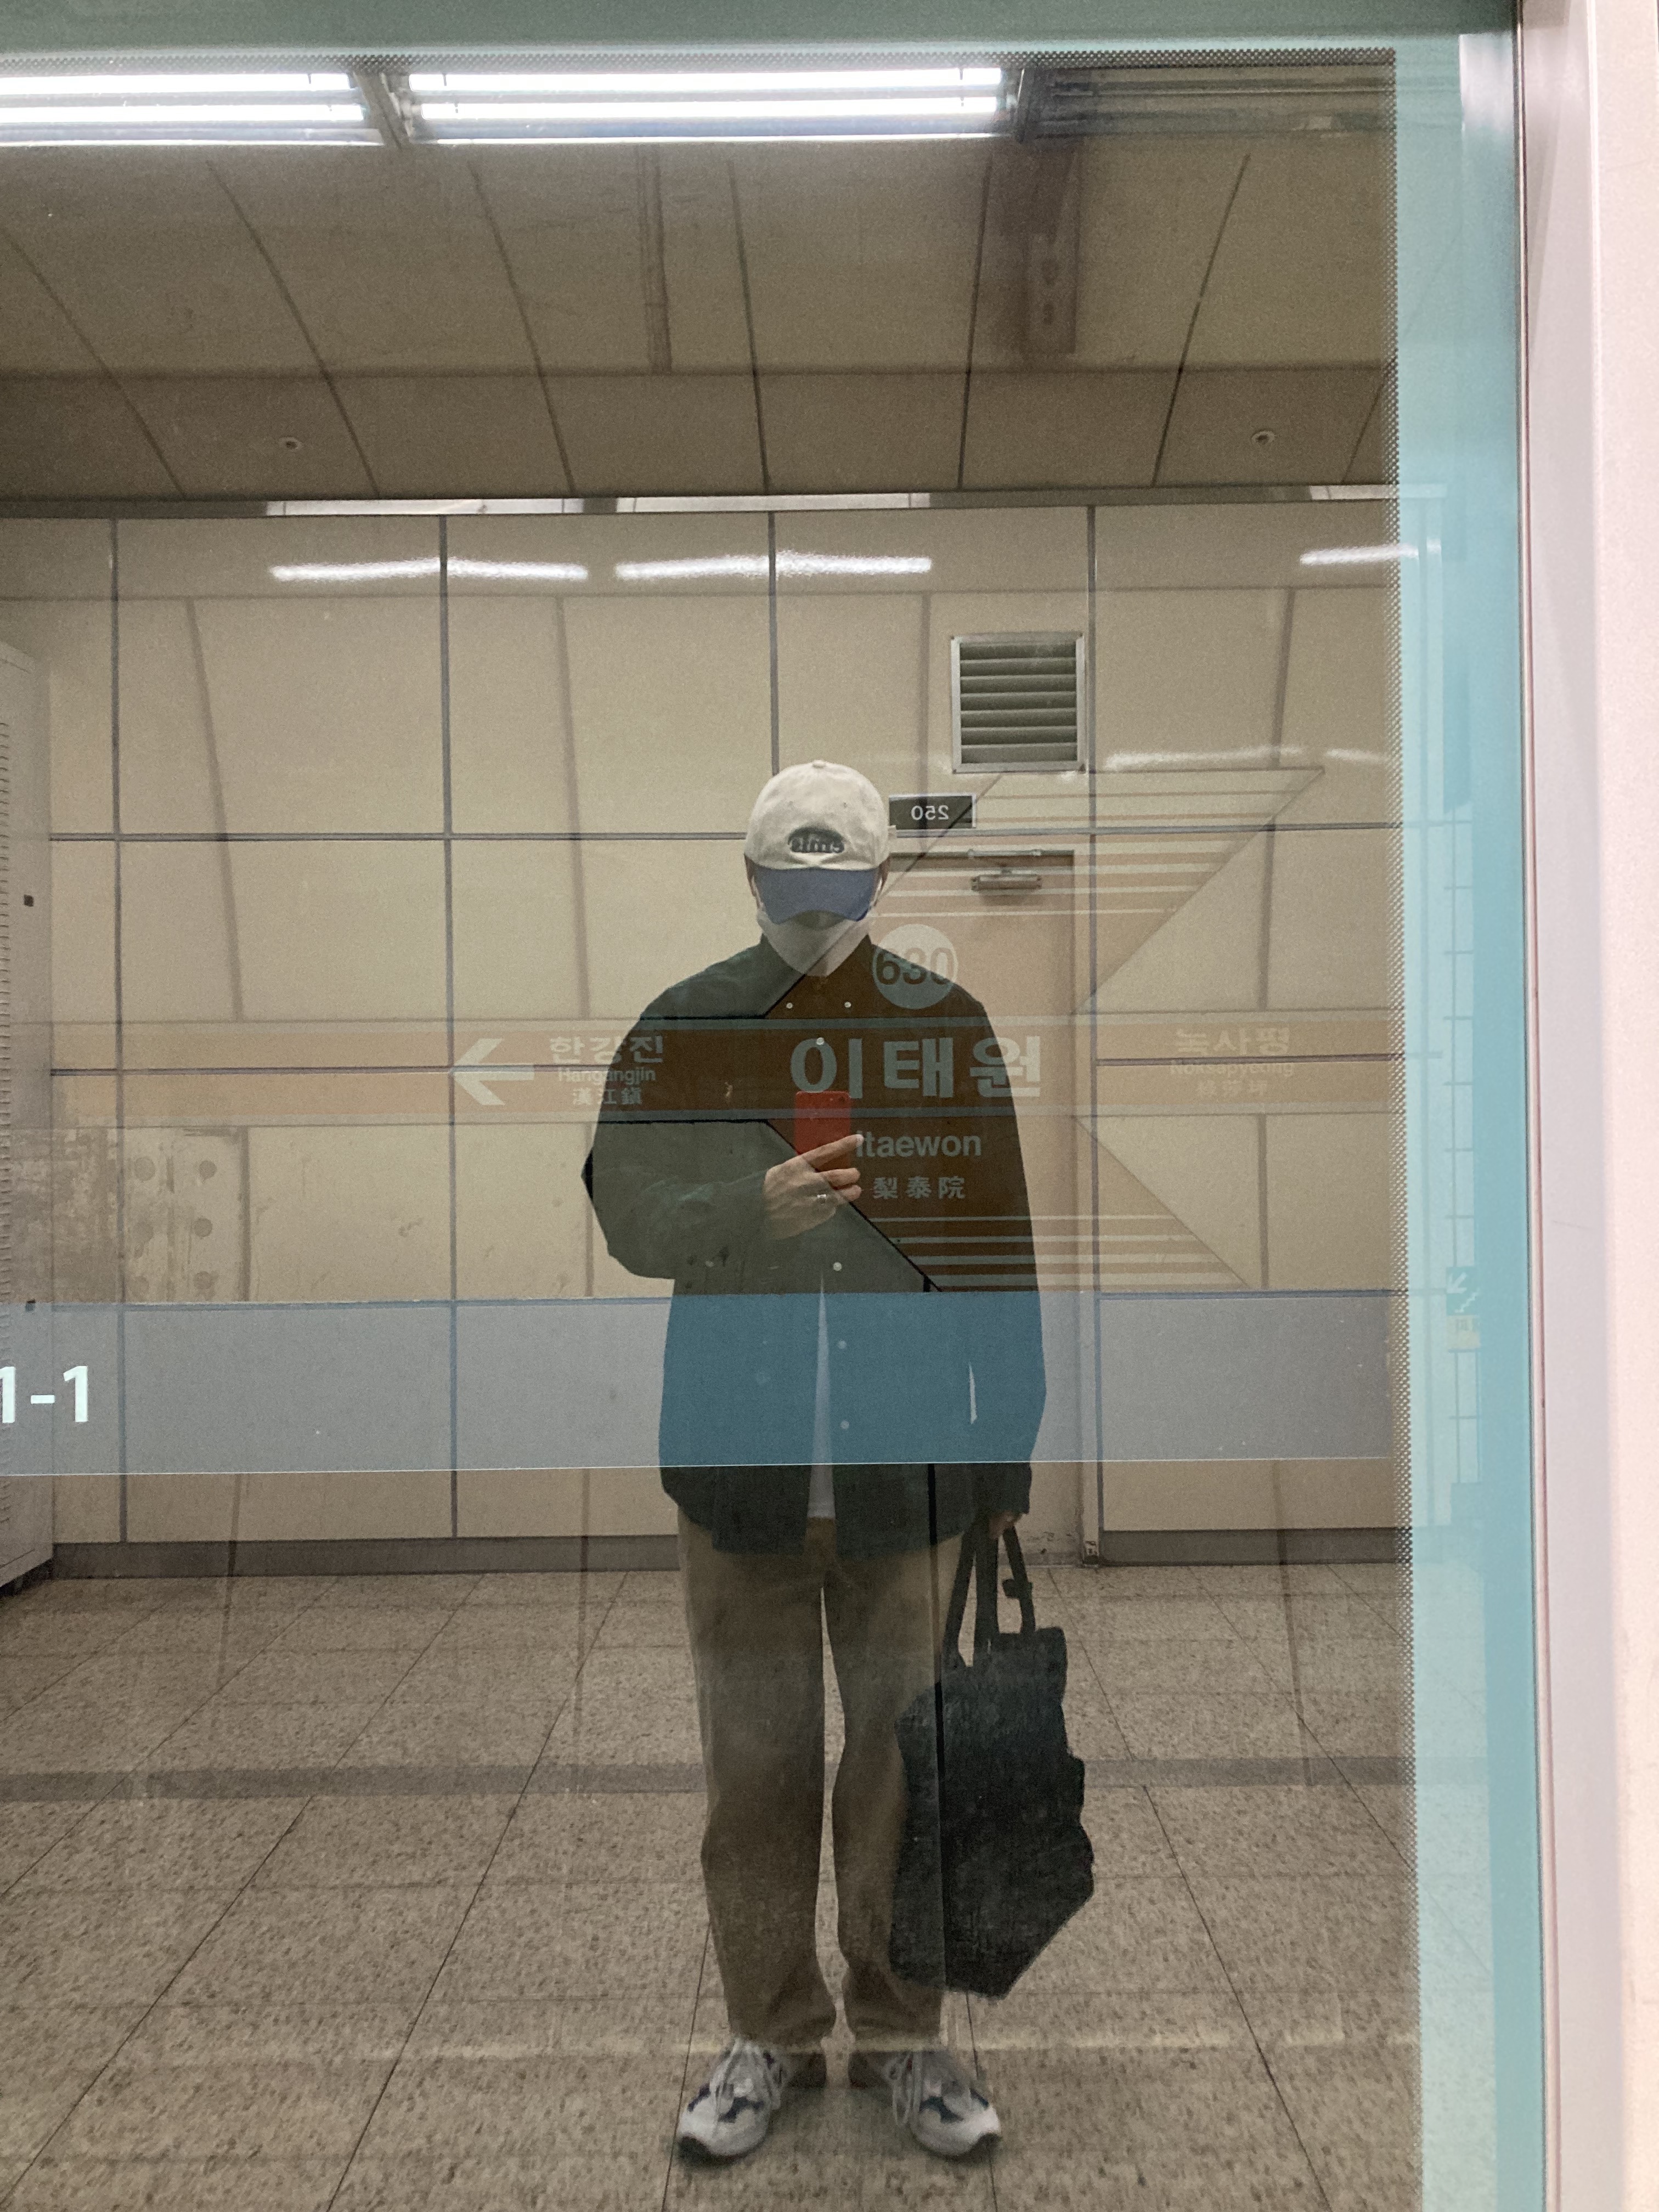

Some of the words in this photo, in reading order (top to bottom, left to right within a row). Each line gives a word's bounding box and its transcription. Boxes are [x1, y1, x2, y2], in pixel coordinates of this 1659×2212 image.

[877, 947, 954, 985] 630
[549, 1035, 663, 1063] 한강진
[1175, 1027, 1289, 1056] 녹사평
[790, 1036, 1041, 1098] 이태원
[873, 1176, 966, 1199] 梨泰院
[0, 1365, 88, 1423] 1-1
